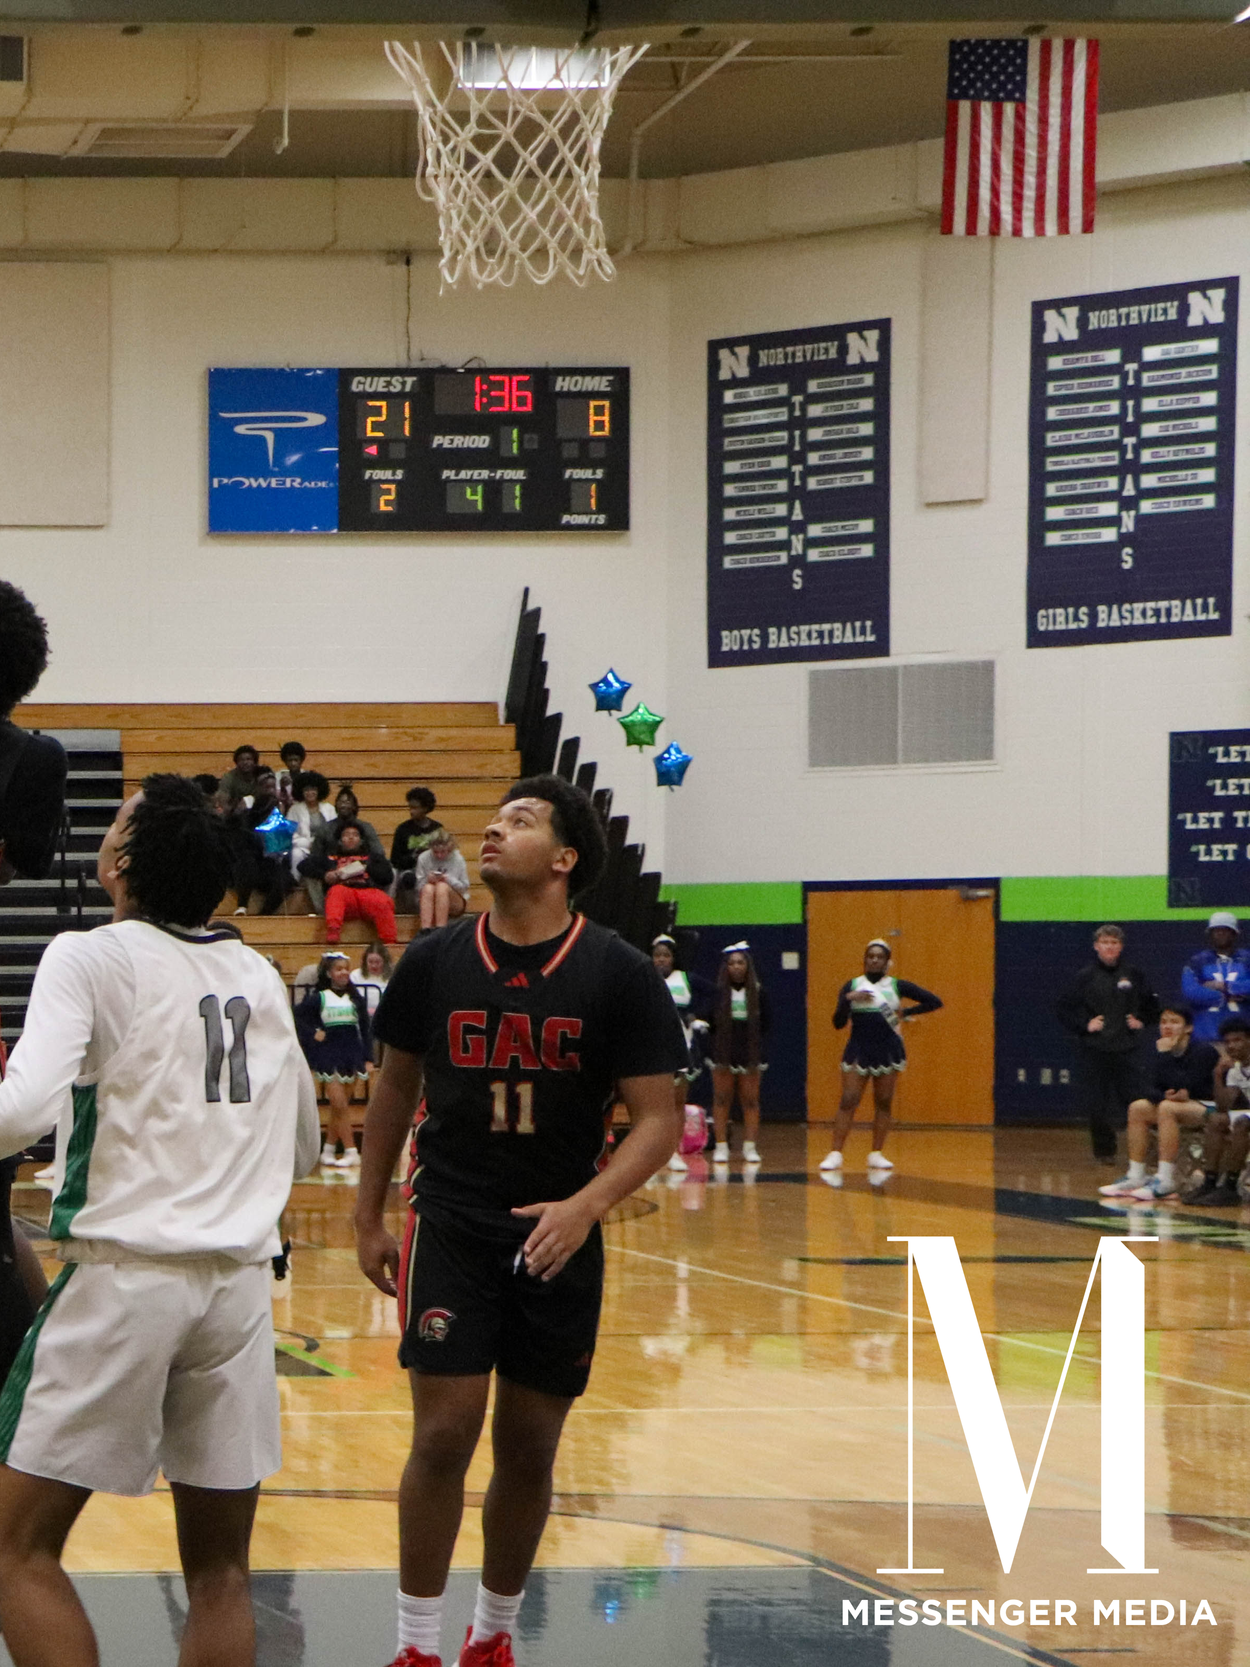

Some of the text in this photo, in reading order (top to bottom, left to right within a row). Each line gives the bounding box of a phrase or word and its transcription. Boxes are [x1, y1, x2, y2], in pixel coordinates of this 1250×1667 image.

[1043, 288, 1226, 343] N NORTHVIEW N
[718, 329, 880, 381] N NORTHVIEW N
[351, 376, 416, 393] GUEST
[474, 375, 532, 412] 1:36
[555, 375, 612, 392] HOME
[366, 401, 410, 437] 21
[589, 401, 610, 437] 8
[432, 435, 490, 449] PERIOD
[212, 477, 330, 489] POWERADE
[364, 470, 404, 480] FOULS
[442, 470, 526, 480] PLAYER-FOUL
[564, 469, 604, 480] FOULS
[379, 485, 396, 511] 2
[466, 486, 483, 511] 4
[561, 515, 606, 525] POINTS
[1037, 598, 1220, 632] GIRLS BASKETBALL
[721, 621, 877, 652] BOYS BASKETBALL
[199, 994, 251, 1103] 11
[448, 1010, 582, 1071] GAC
[490, 1080, 536, 1134] 11
